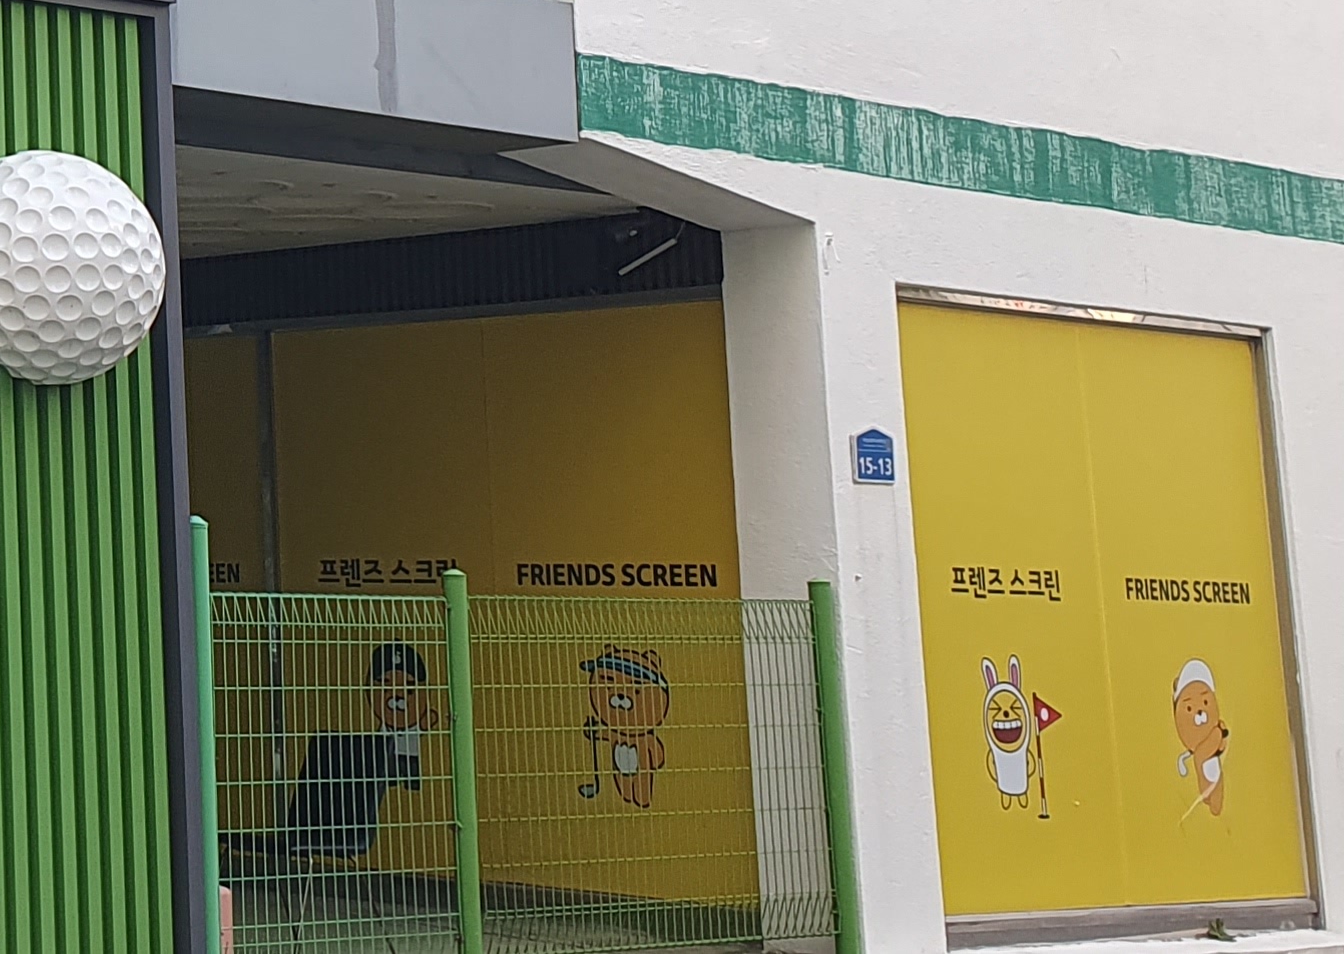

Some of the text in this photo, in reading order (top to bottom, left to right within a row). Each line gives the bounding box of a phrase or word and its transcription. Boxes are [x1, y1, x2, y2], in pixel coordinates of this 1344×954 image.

[859, 457, 892, 476] 15-13
[318, 558, 384, 588] 프렌즈
[516, 563, 718, 588] FRIENDS SCREEN
[950, 566, 1062, 602] 프렌즈 스크린
[1124, 576, 1251, 605] FRIENDS SCREEN
